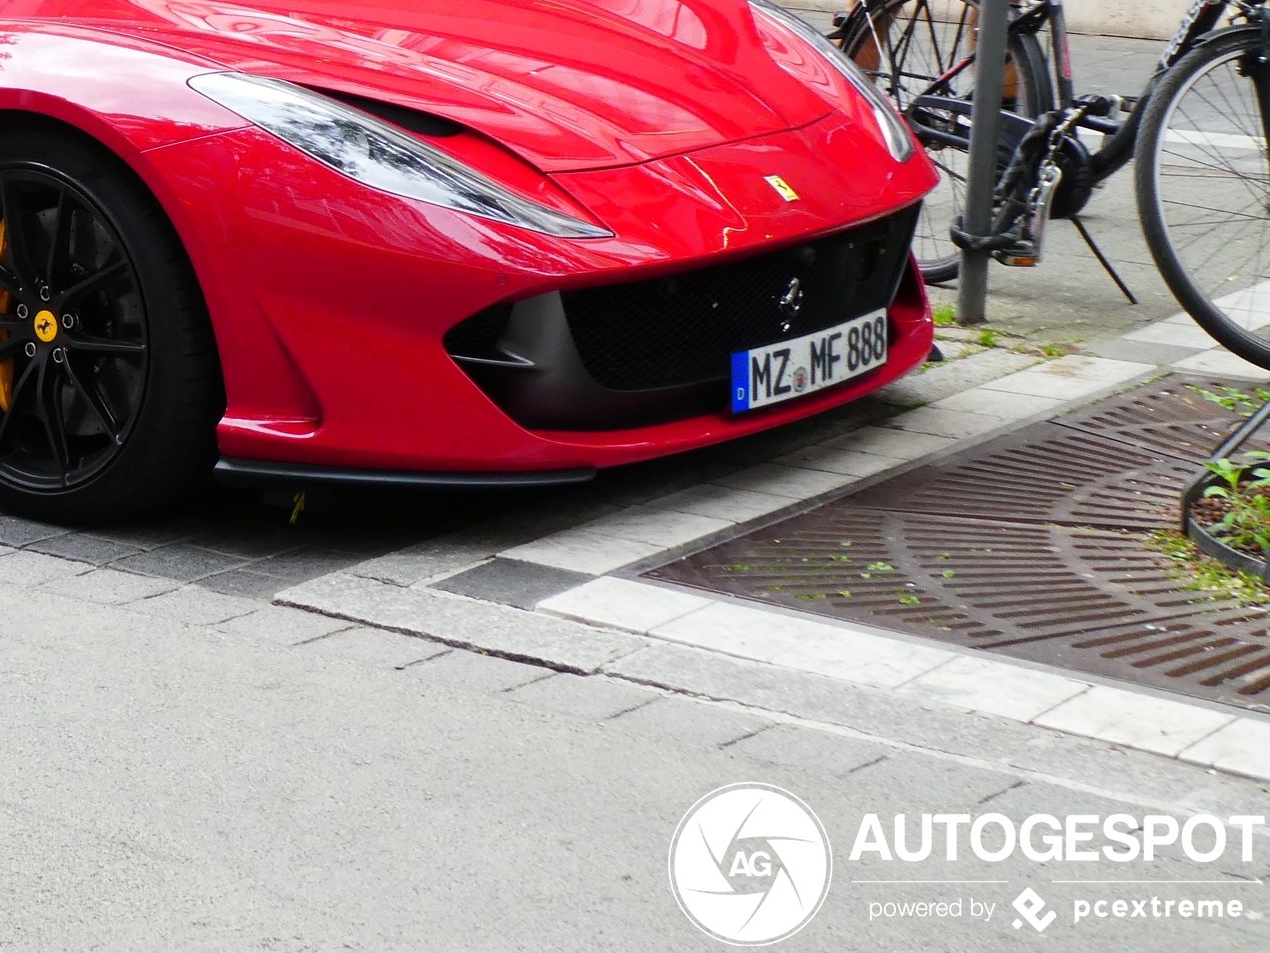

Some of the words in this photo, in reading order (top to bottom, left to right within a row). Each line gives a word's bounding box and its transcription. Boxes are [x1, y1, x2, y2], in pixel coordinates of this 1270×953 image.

[751, 347, 792, 402] MZ
[810, 332, 843, 385] MF
[847, 315, 886, 372] 888
[736, 387, 745, 401] D
